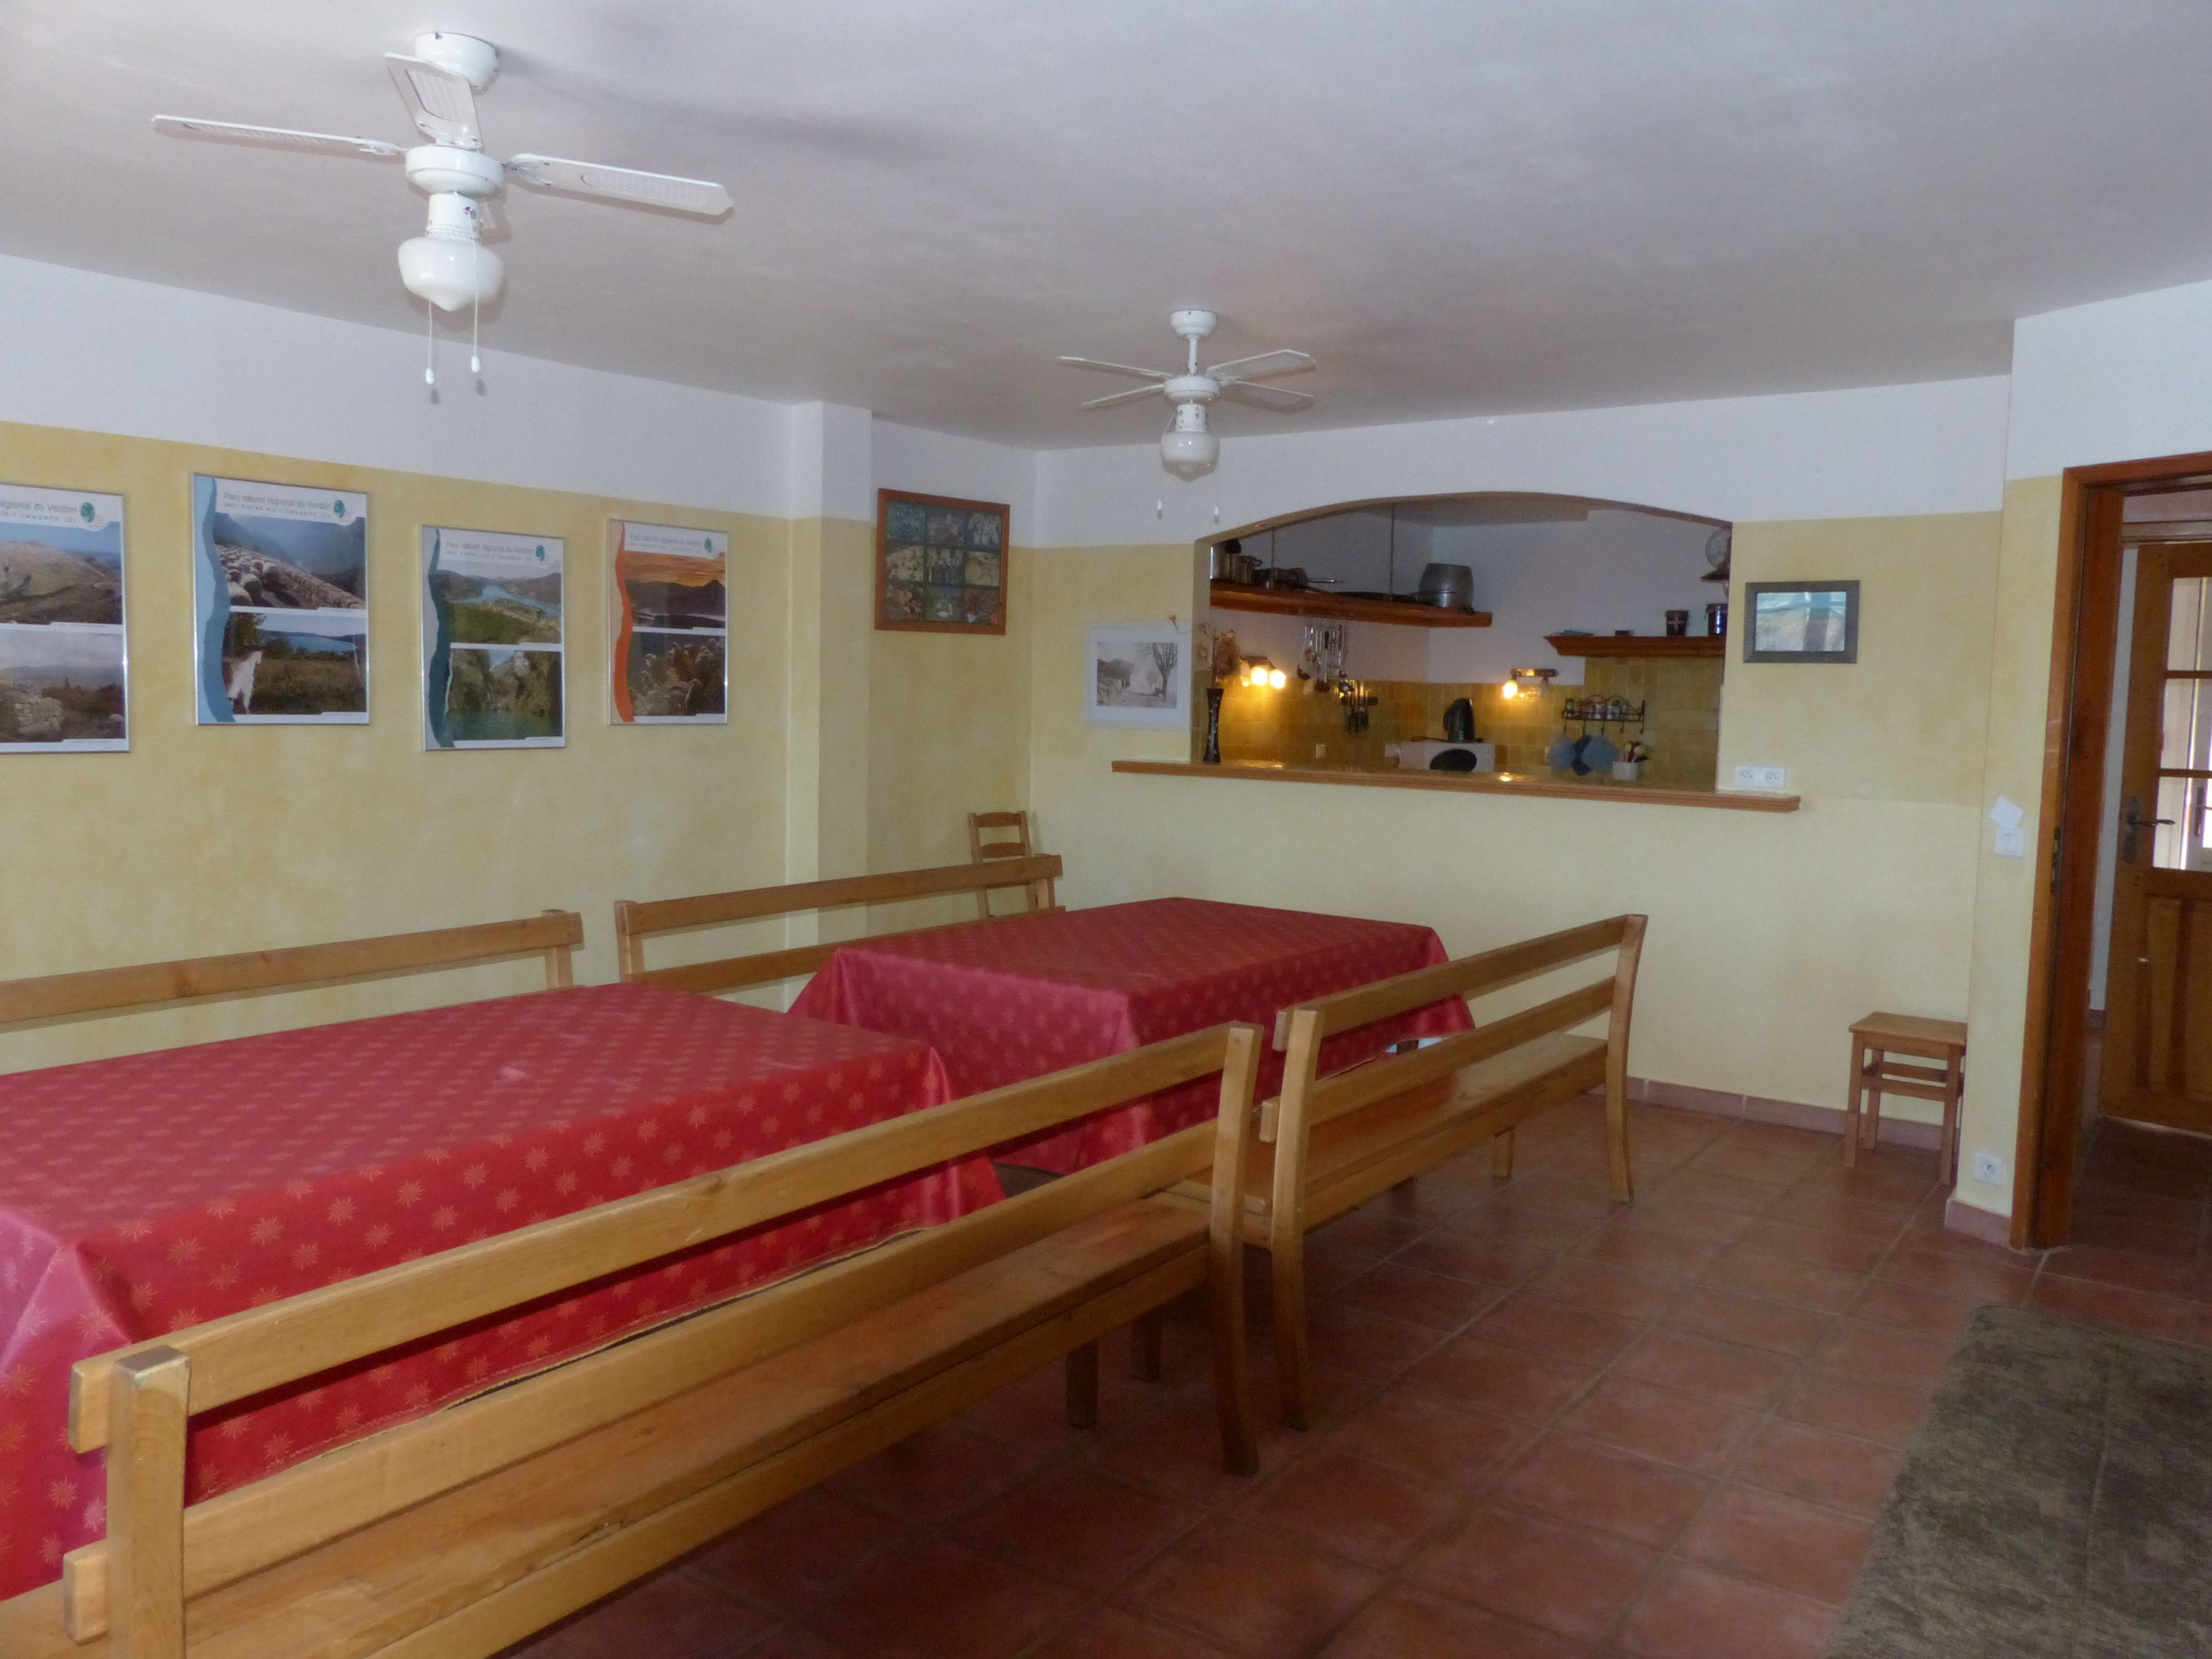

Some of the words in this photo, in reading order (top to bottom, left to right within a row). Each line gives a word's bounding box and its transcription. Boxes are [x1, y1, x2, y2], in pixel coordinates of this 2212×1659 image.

[0, 500, 31, 510] égional
[33, 502, 44, 511] du
[47, 503, 77, 513] Verdon
[224, 492, 240, 501] Parc
[242, 495, 266, 503] naturel
[307, 501, 331, 510] Verdon
